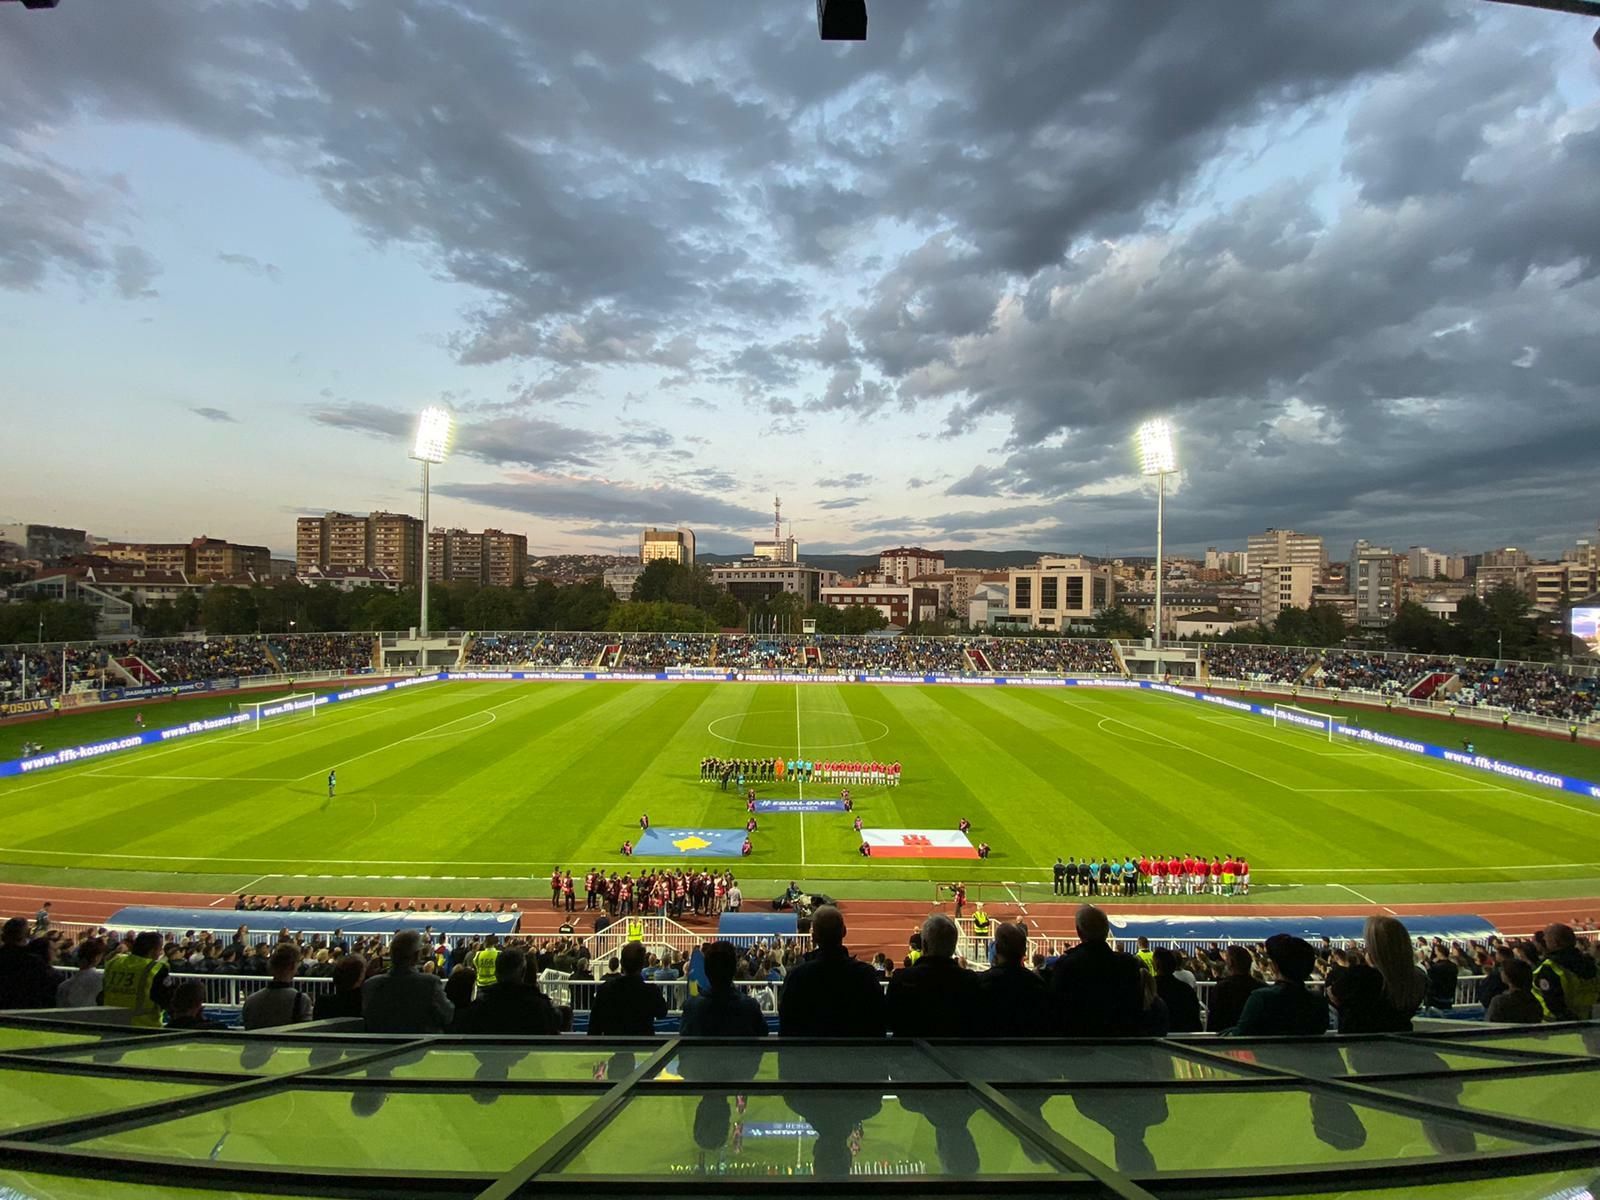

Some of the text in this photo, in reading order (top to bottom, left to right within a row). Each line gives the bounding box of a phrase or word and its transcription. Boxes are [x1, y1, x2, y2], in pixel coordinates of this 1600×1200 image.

[7, 700, 48, 714] OSOVA
[162, 712, 250, 739] www.ffk-kosova.com
[1338, 724, 1424, 754] www.ffk-kosova.com
[20, 736, 142, 772] www.ffk-kosova.com
[1443, 750, 1563, 789] www.ffk-kosova.com
